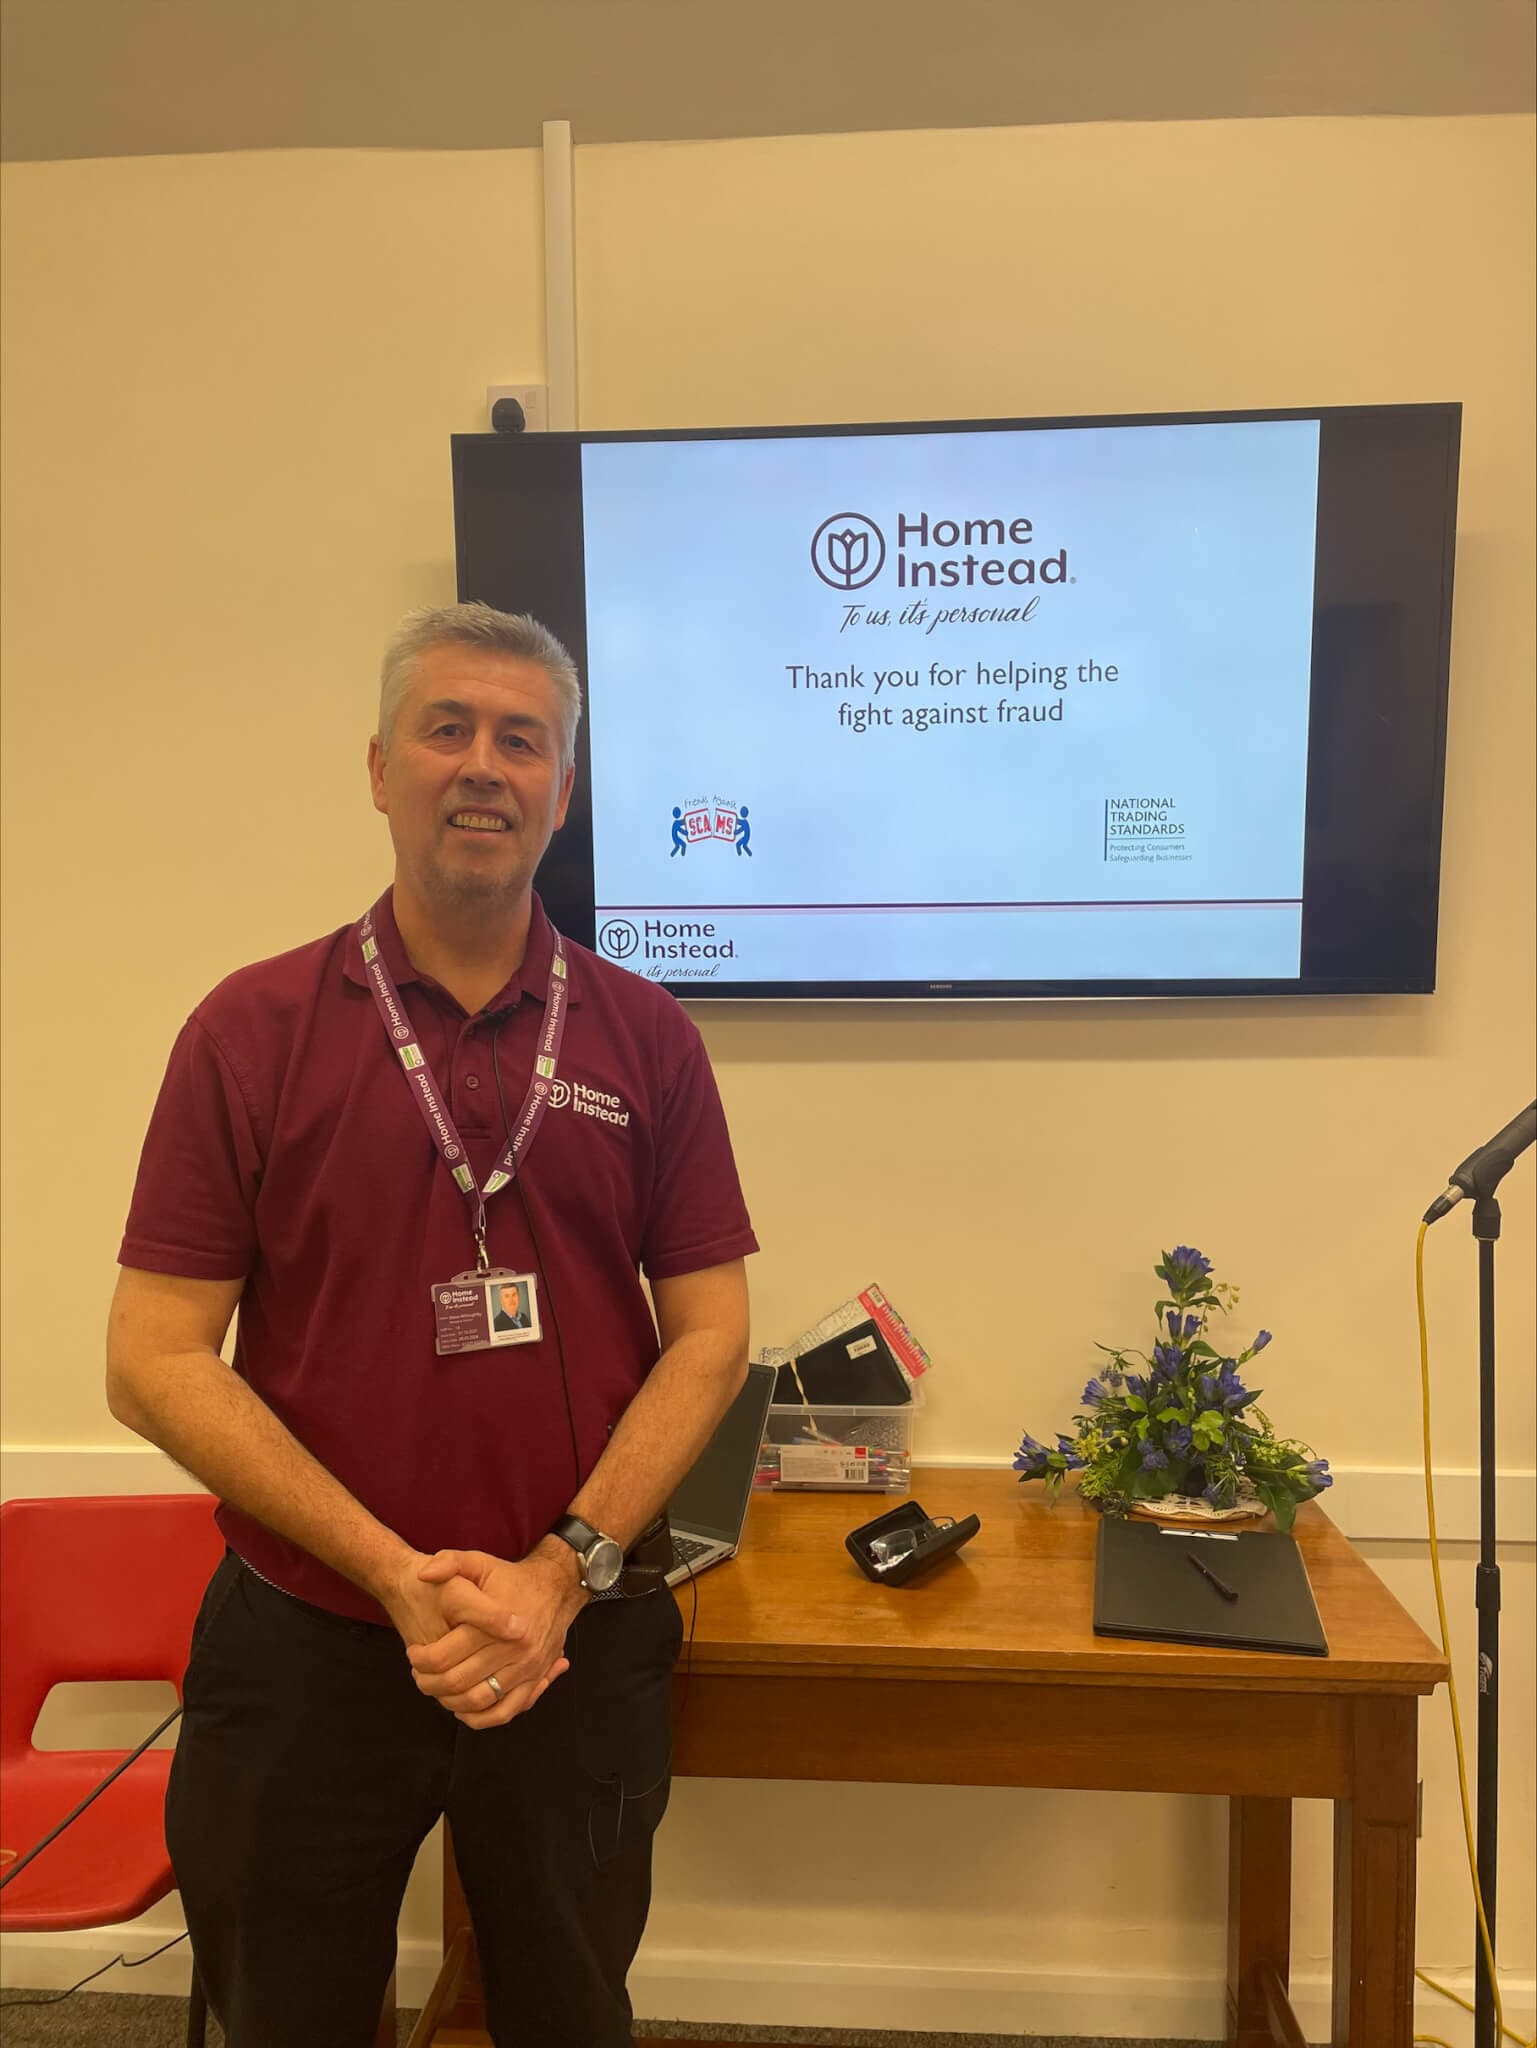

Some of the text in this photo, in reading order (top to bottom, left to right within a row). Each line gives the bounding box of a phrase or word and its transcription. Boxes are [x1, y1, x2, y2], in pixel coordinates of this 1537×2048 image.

[898, 511, 1033, 548] Home
[898, 548, 1067, 588] Instead
[840, 604, 866, 633] To
[866, 609, 892, 627] us,
[925, 595, 1041, 635] personal
[785, 658, 1119, 694] Thank you for helping the
[838, 698, 1063, 733] fight against fraud
[1110, 797, 1176, 809] NATIONAL
[1110, 811, 1168, 822] TRADING
[1109, 823, 1185, 835] STANDARDS
[645, 919, 716, 938] Home
[645, 939, 735, 959] Instead
[660, 963, 721, 982] personal
[370, 963, 403, 1027] Home Instead
[543, 992, 562, 1053] Home Instead
[415, 1073, 453, 1146] Home Instead
[524, 1093, 544, 1127] Home
[572, 1095, 630, 1128] Instead
[573, 1081, 621, 1109] Home
